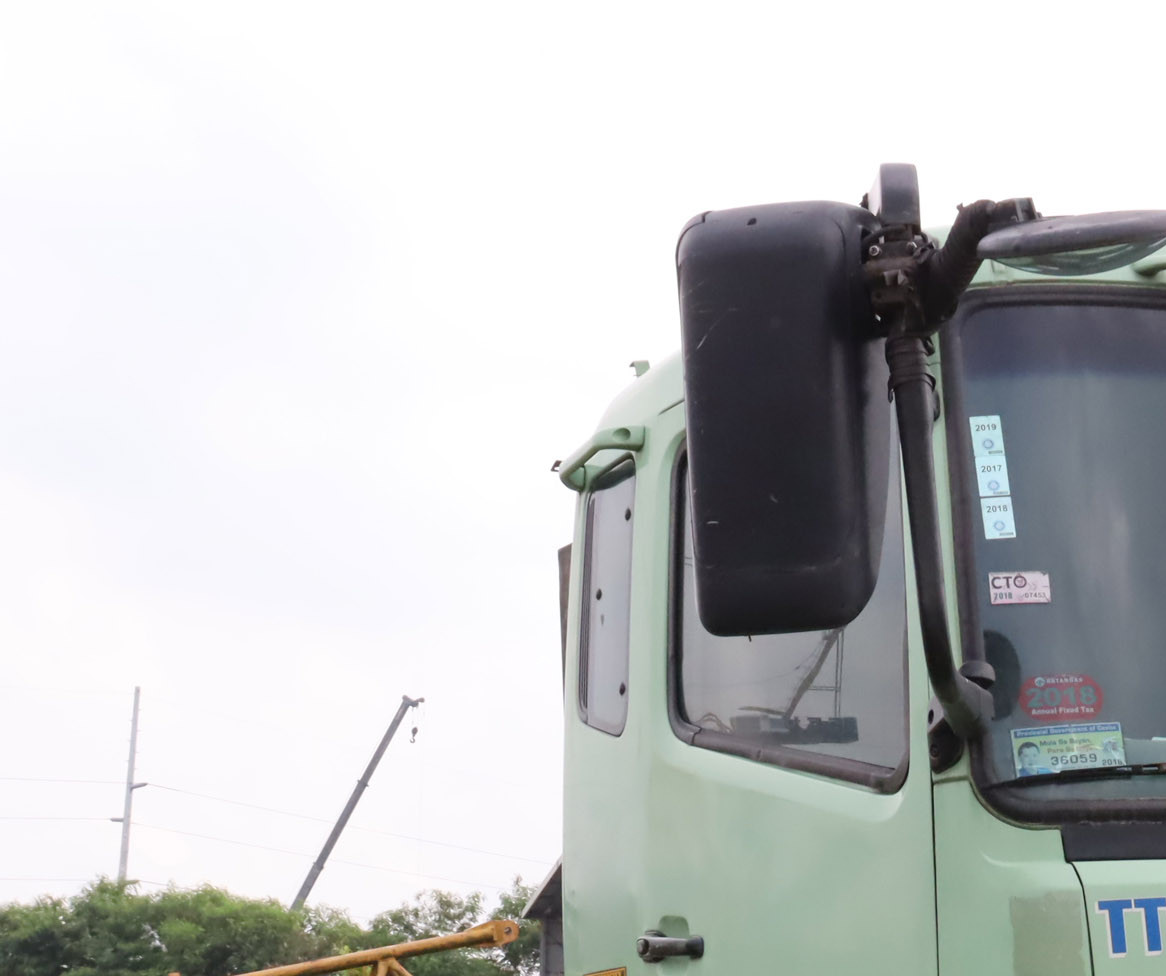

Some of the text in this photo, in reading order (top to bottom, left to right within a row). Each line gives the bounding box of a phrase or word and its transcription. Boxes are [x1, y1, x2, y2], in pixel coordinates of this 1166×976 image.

[975, 424, 997, 432] 2019
[981, 465, 1002, 473] 2017
[986, 505, 1008, 513] 2018
[991, 575, 1027, 589] CTO
[1025, 685, 1097, 707] 2018
[1031, 707, 1057, 715] Annual
[1059, 706, 1079, 714] Fixed
[1051, 753, 1097, 766] 36059
